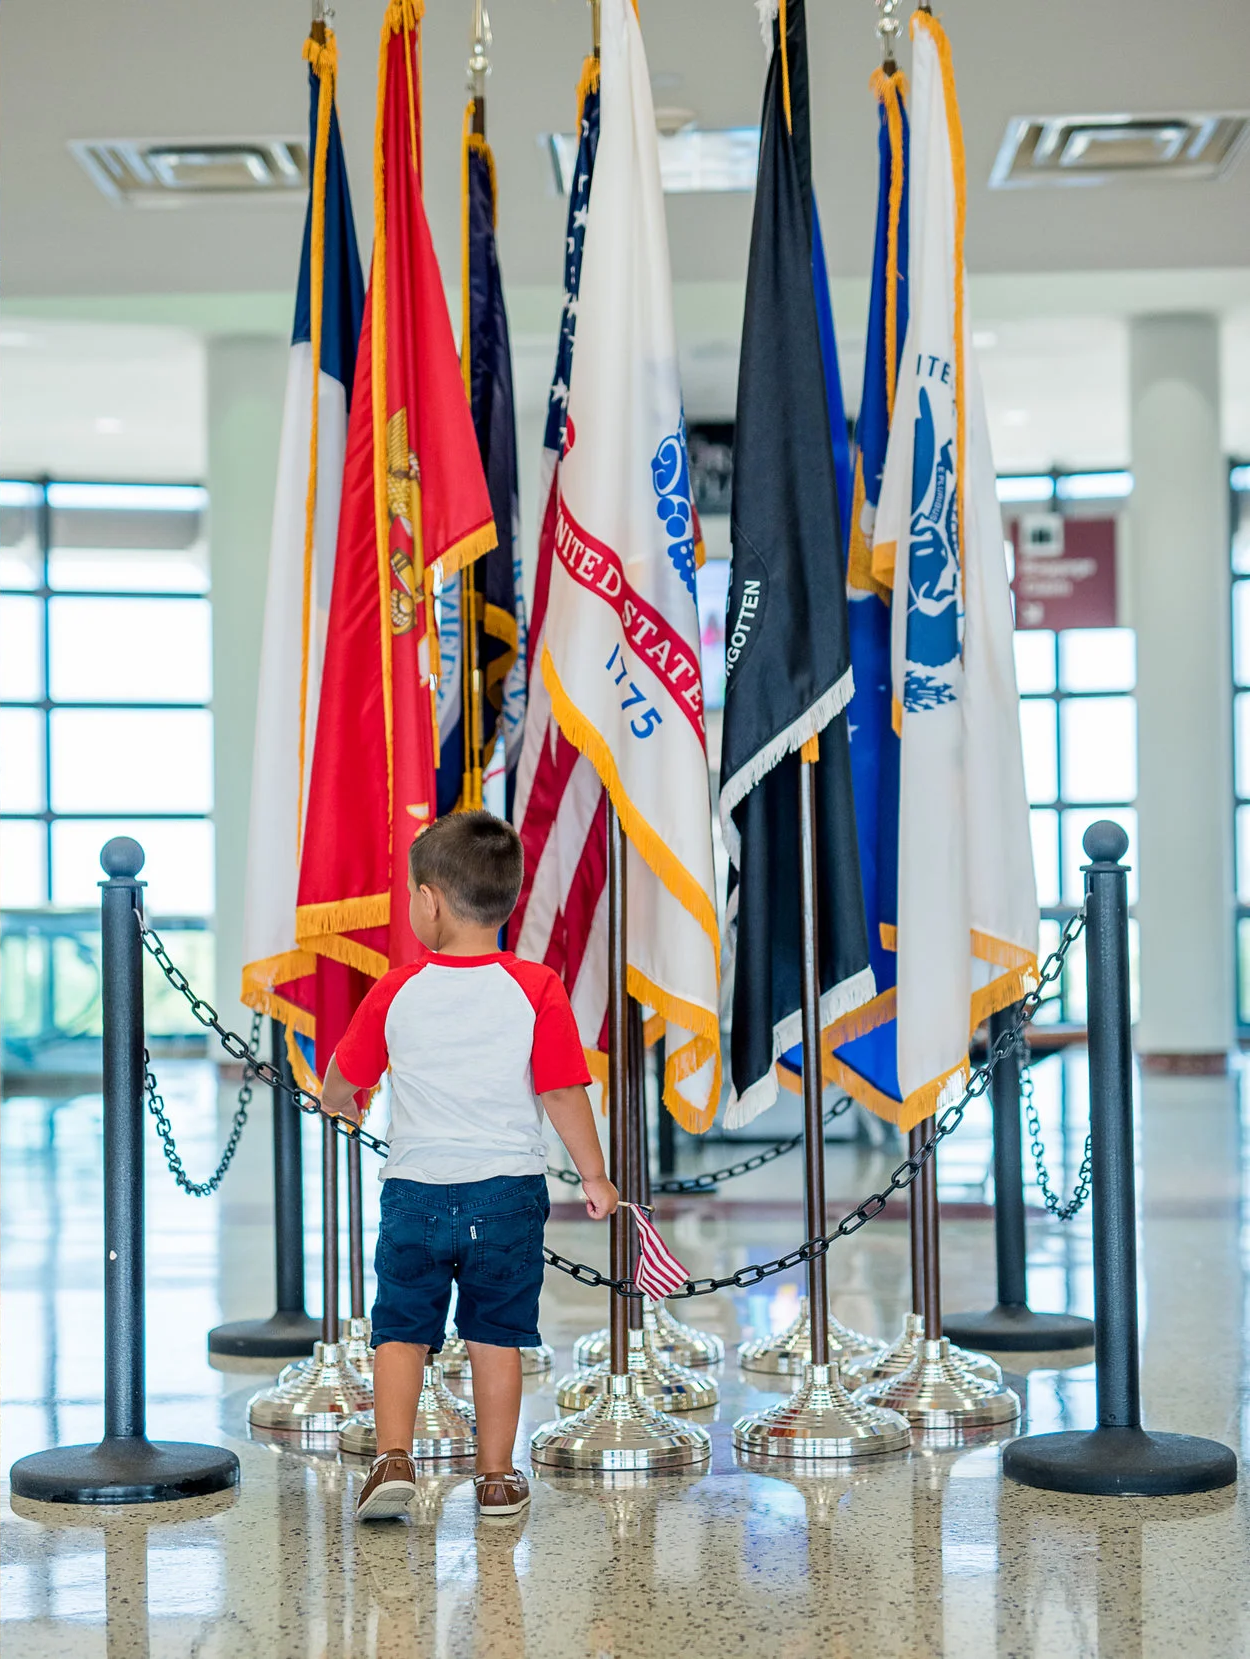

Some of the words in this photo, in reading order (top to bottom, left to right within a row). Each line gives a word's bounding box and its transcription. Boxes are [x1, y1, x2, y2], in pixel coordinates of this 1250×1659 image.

[916, 353, 951, 385] ITE
[554, 512, 622, 598] NITED
[605, 642, 663, 739] 1775
